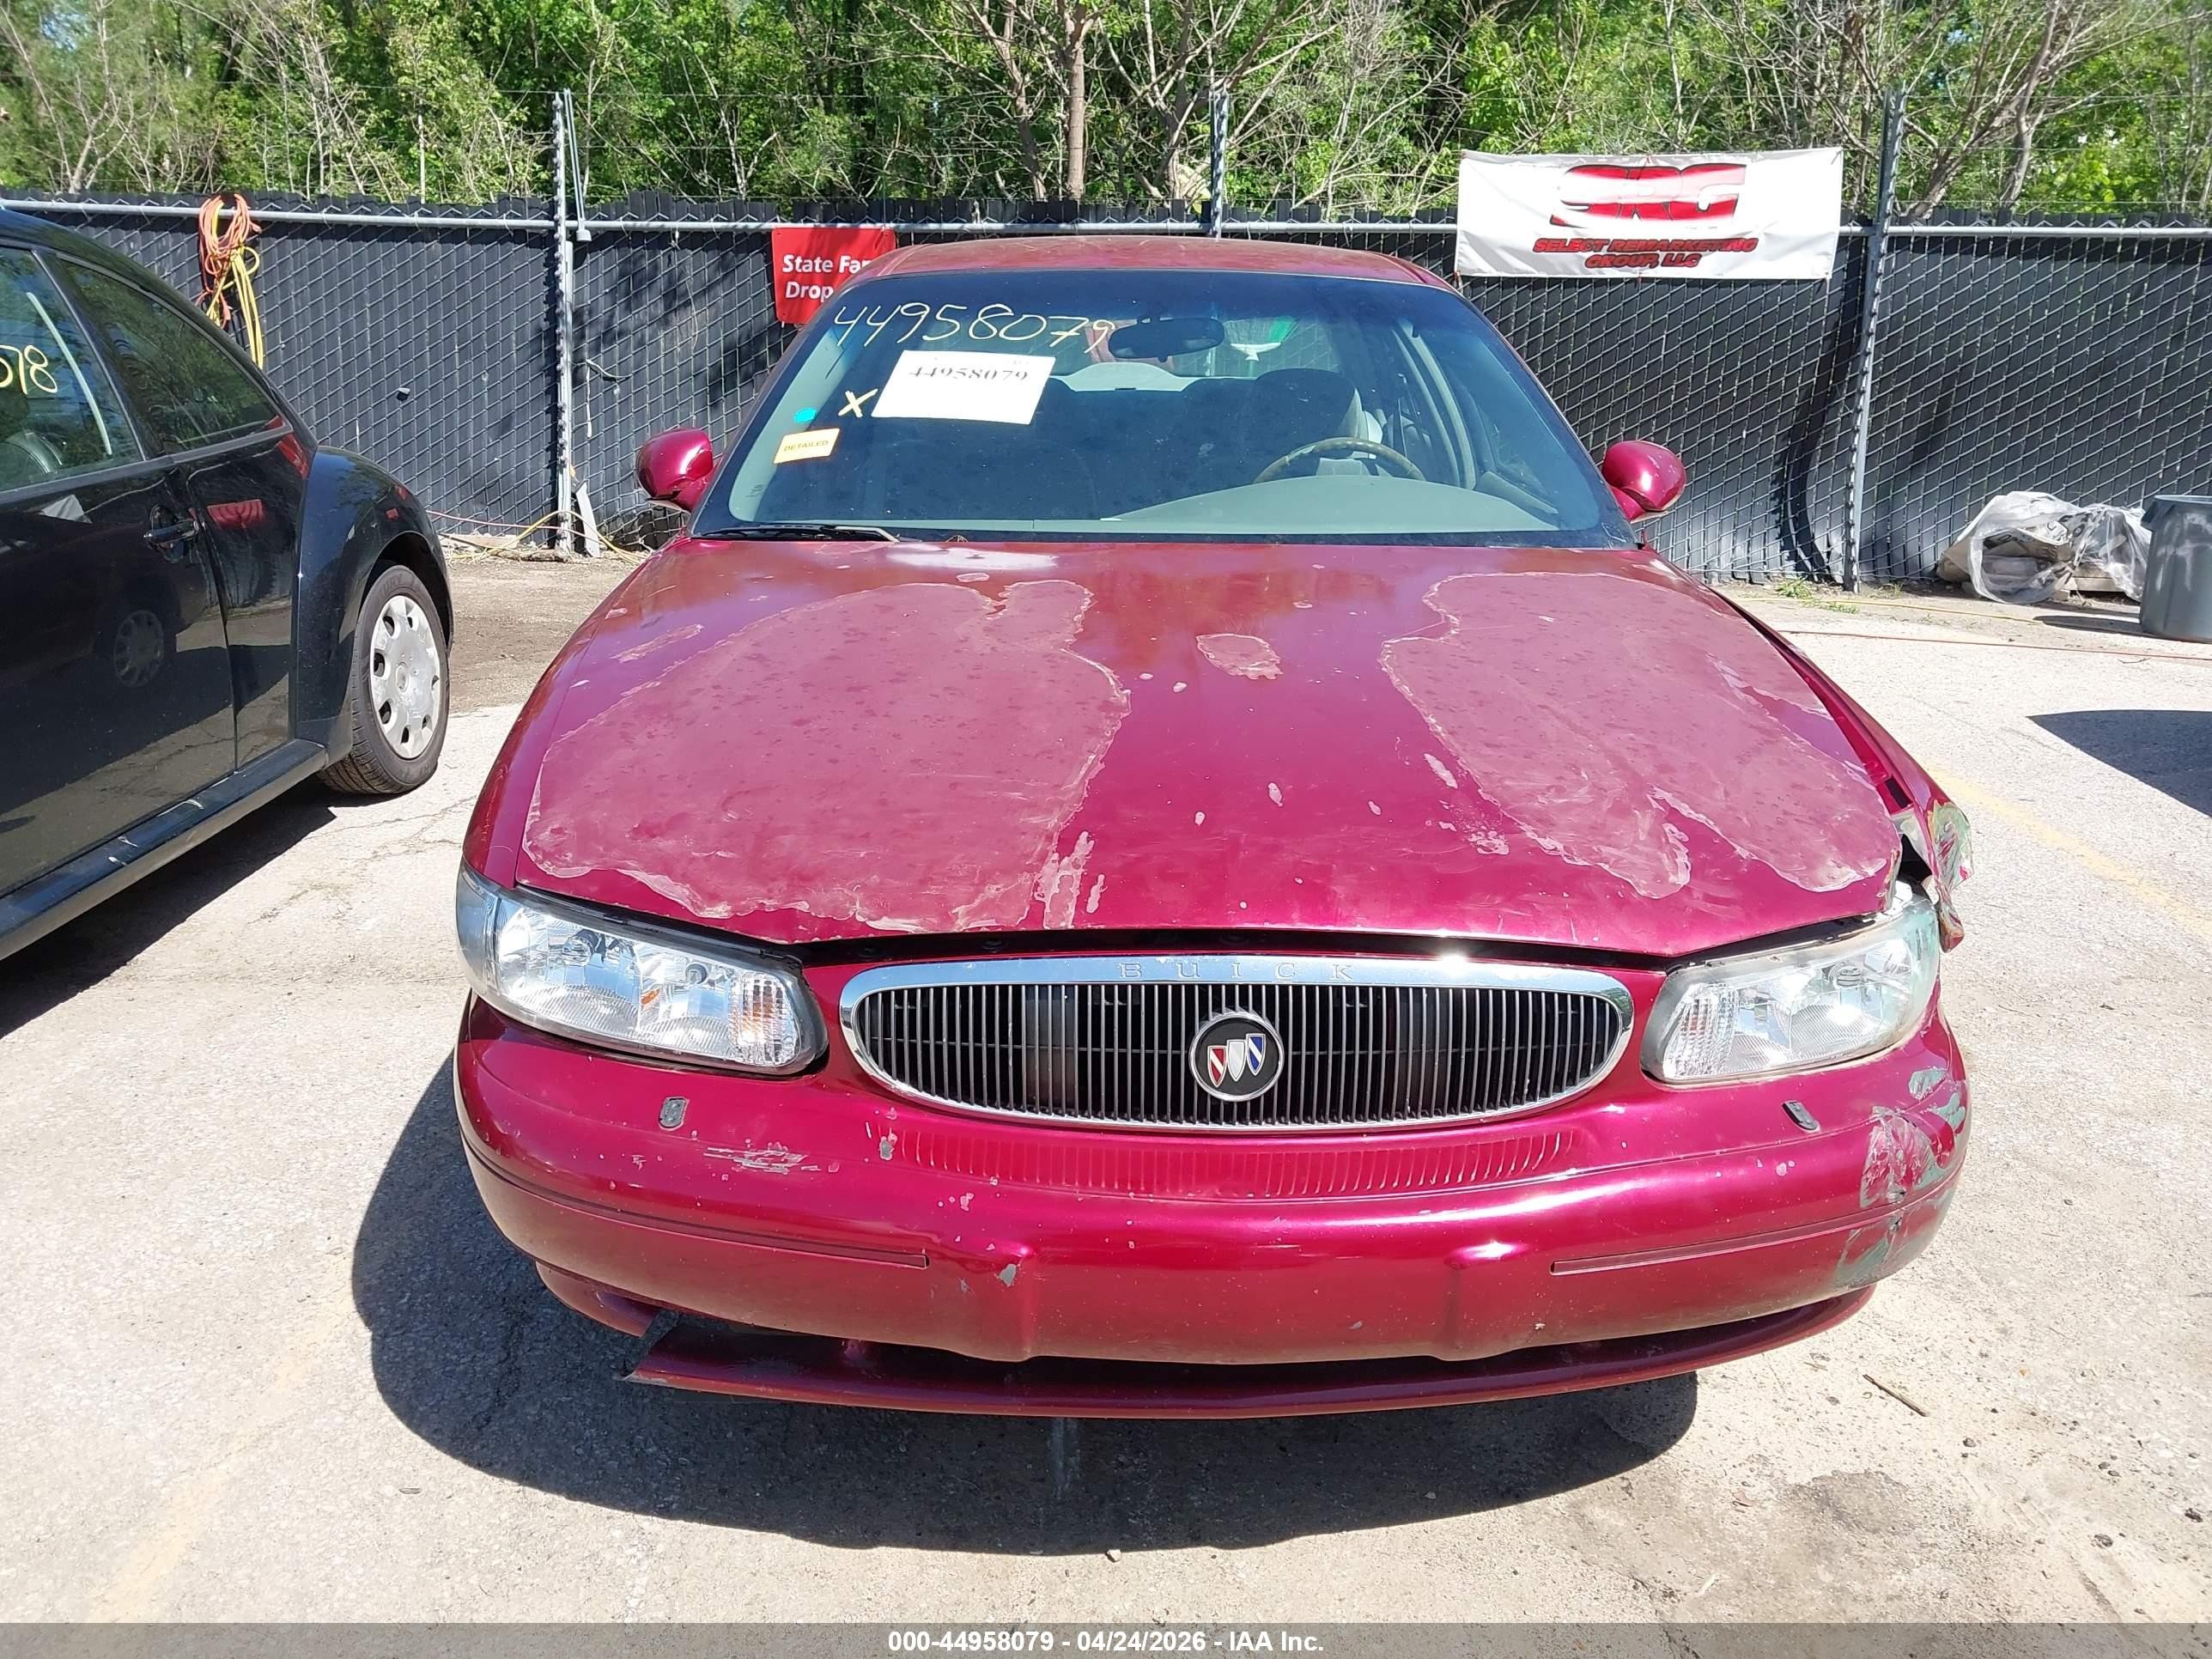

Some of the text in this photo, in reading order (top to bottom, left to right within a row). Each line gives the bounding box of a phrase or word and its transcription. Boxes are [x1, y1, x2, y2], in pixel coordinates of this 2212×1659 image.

[1533, 237, 1759, 253] SELECT REMARKETING
[781, 254, 834, 273] State
[1584, 252, 1703, 269] GROUP, LLC
[833, 301, 1115, 354] 44958079
[908, 366, 1029, 382] 44958079
[783, 440, 830, 453] DETAILED
[1118, 962, 1353, 981] BUICK
